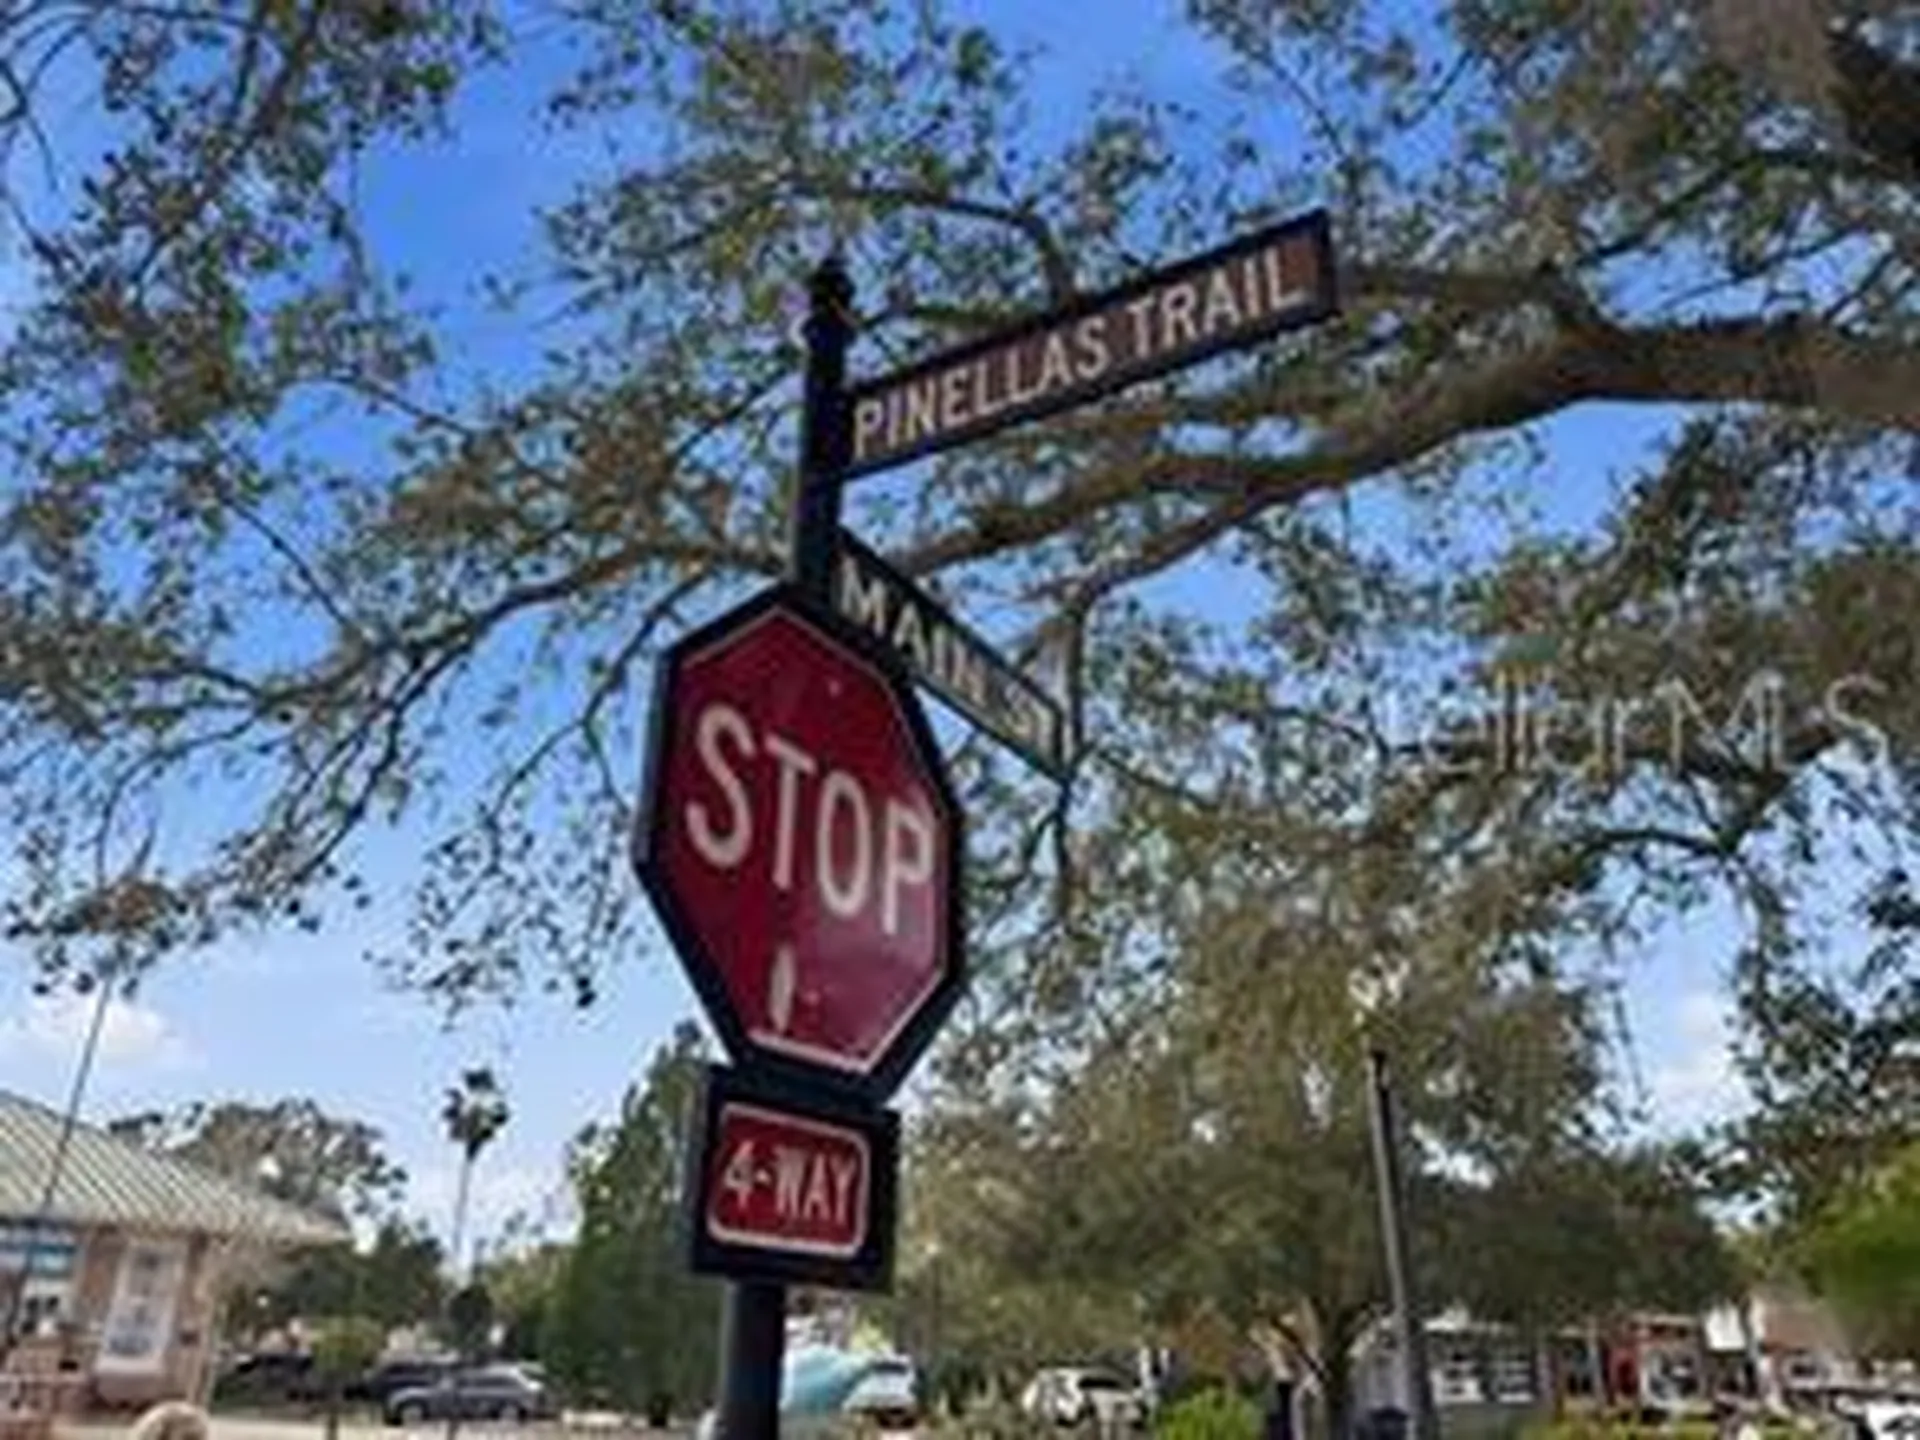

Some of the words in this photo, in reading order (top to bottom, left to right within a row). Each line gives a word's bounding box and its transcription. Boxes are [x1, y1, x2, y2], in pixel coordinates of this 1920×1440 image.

[853, 316, 1109, 458] PINELLAS
[1131, 245, 1304, 357] TRAIL
[838, 553, 987, 708] MAIN
[685, 703, 936, 936] STOP
[724, 1140, 857, 1226] 4-WAY
